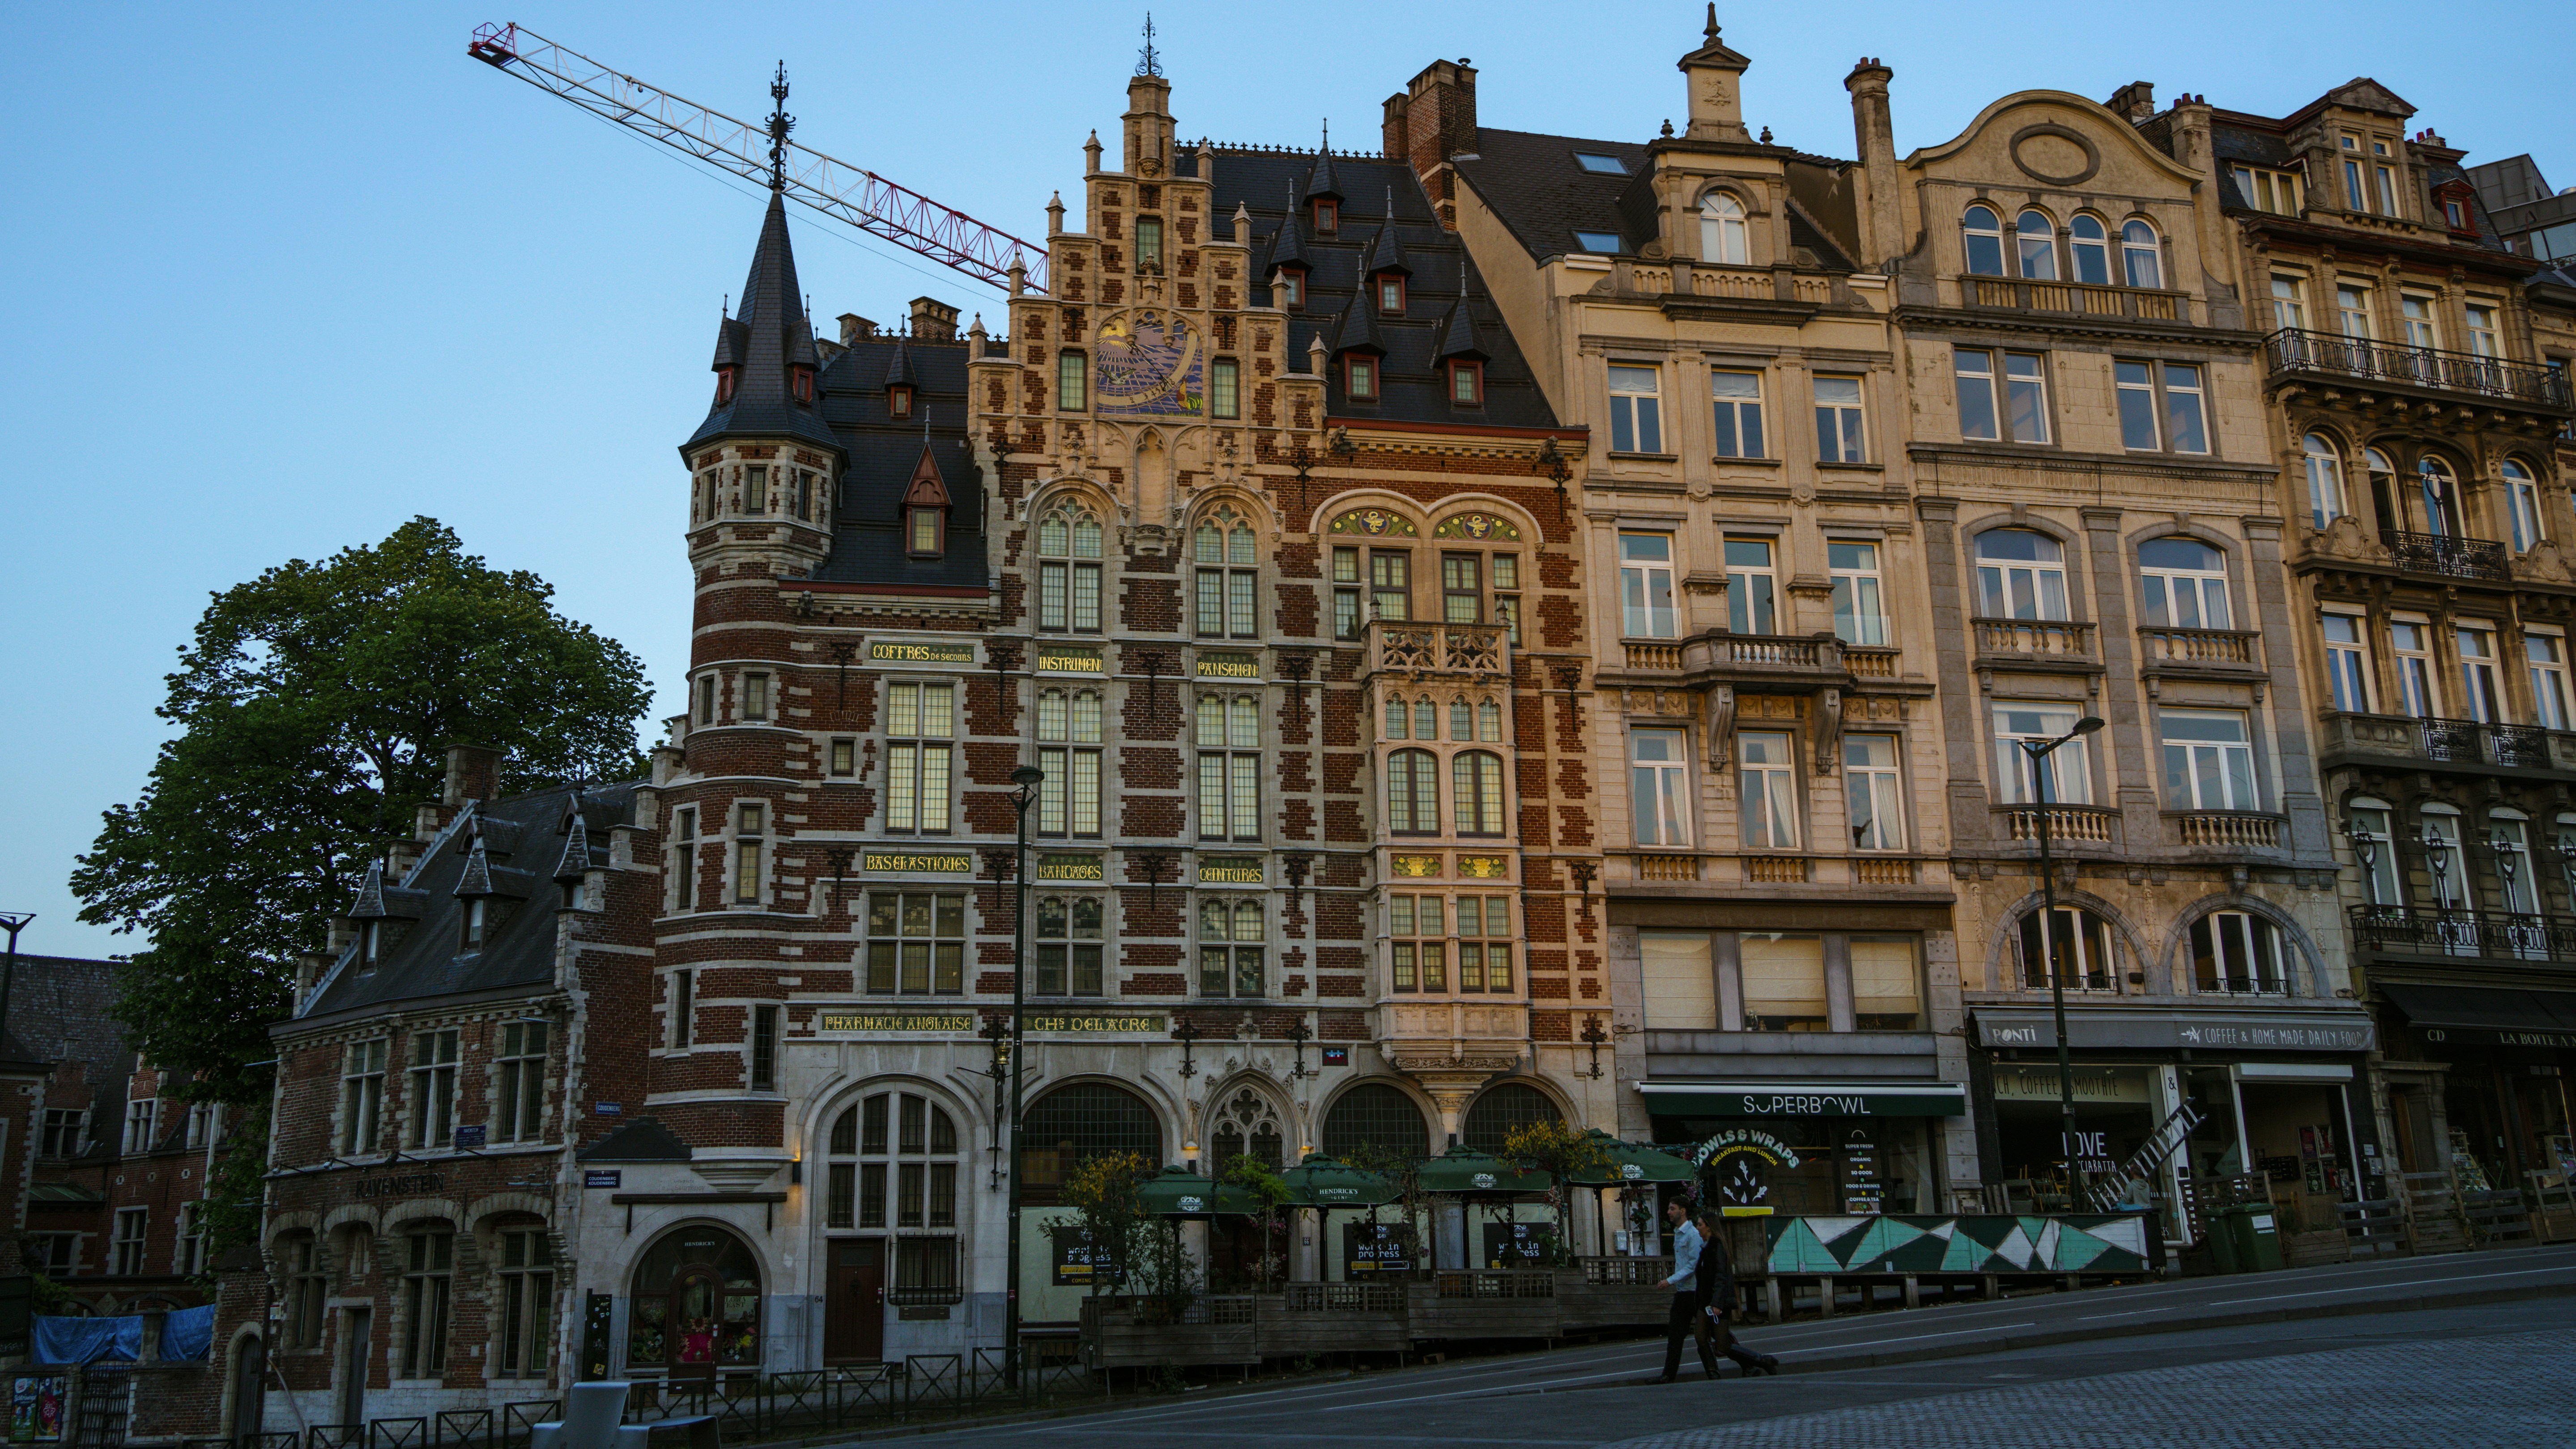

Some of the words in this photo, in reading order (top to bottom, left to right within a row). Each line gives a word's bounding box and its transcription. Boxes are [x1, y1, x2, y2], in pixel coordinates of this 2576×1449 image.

[873, 645, 929, 660] COFFRES
[941, 653, 971, 661] SECOURS
[866, 855, 891, 870] BAS
[893, 856, 969, 871] ELASTIQUES
[1038, 865, 1102, 880] BANDAGES
[1199, 868, 1263, 882] CEINTURES
[824, 1016, 903, 1030] PHARMACIE
[906, 1016, 971, 1031] ANGLAISE
[1071, 1018, 1150, 1031] DELACRE
[2205, 1028, 2236, 1044] COFFEE
[2241, 1031, 2248, 1042] &
[2252, 1029, 2276, 1044] HOME
[2279, 1029, 2305, 1045] MADE
[2308, 1030, 2337, 1046] DAILY
[2341, 1031, 2363, 1046] FOOD
[2427, 1029, 2445, 1042] CD
[2499, 1032, 2517, 1044] LA
[2519, 1033, 2556, 1046] BOITE
[2560, 1035, 2568, 1046] A
[2168, 1076, 2176, 1090] &
[1744, 1095, 1870, 1113] SUPERBOWL
[1698, 1129, 1735, 1166] OWLS
[1737, 1129, 1747, 1142] &
[1750, 1129, 1800, 1169] WRAPS
[1711, 1146, 1742, 1167] BREAKFAST
[1757, 1149, 1778, 1167] LUNCH
[356, 1173, 445, 1198] RAVENSTEIN
[1388, 1242, 1399, 1250] in
[1528, 1241, 1539, 1249] in
[1358, 1251, 1400, 1260] proress
